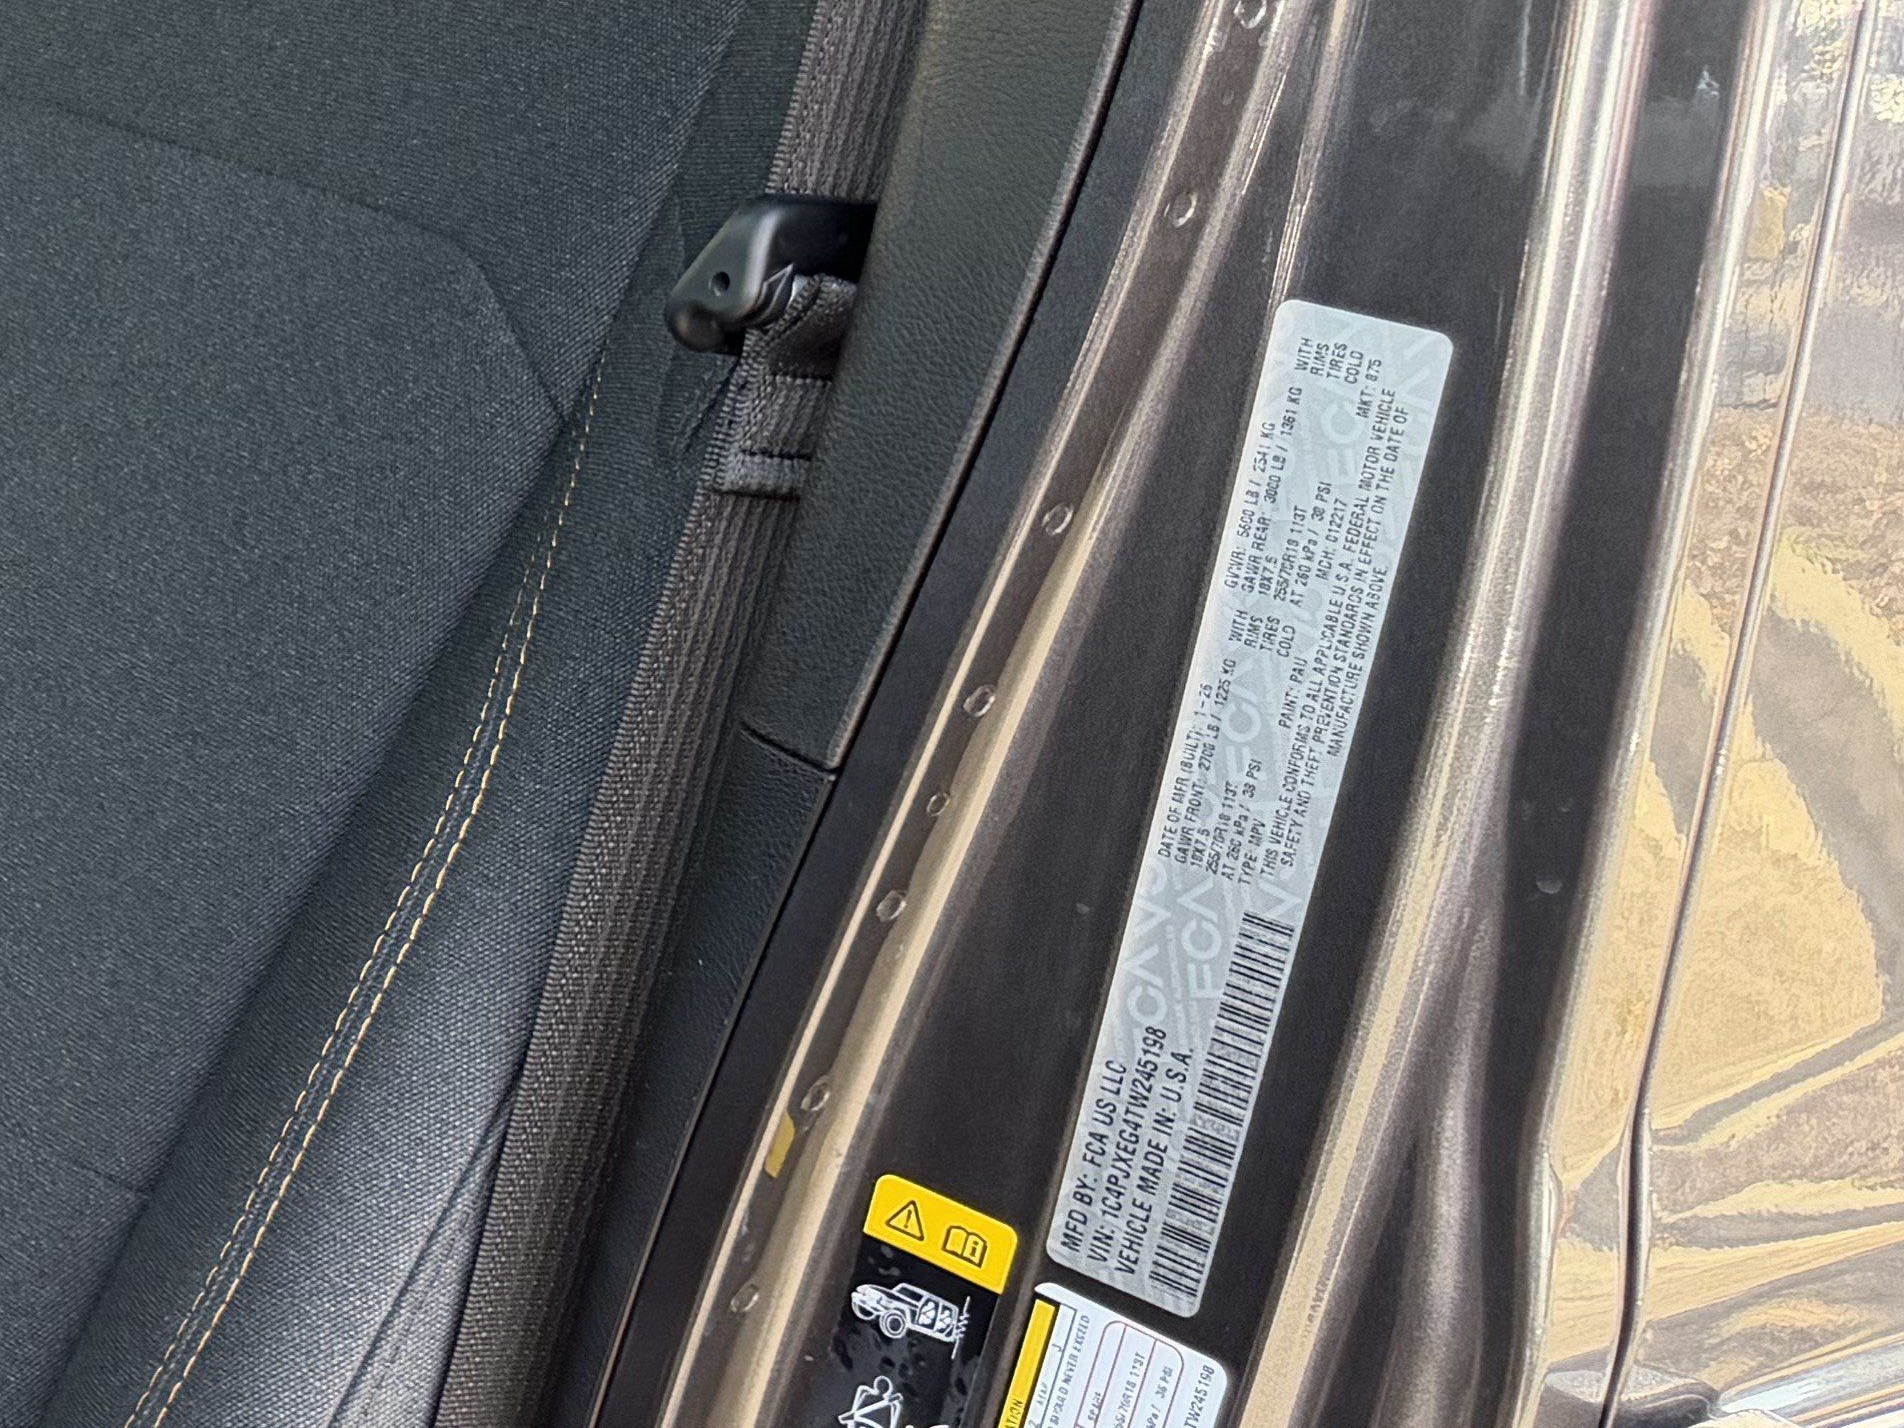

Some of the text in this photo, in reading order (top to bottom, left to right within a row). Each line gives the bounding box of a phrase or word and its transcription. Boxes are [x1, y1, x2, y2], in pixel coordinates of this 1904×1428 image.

[1293, 336, 1315, 372] WITH
[1309, 341, 1330, 376] RIMS
[1325, 340, 1348, 381] TIRES
[1342, 349, 1364, 385] COLD
[1369, 387, 1396, 441] VEHICLE
[1392, 404, 1410, 424] OF
[1243, 488, 1260, 505] LB
[1259, 420, 1276, 440] KG
[1382, 426, 1405, 462] DATE
[1357, 444, 1382, 491] MOTOR
[1375, 464, 1395, 492] THE
[1240, 553, 1262, 594] GAWR
[1285, 385, 1303, 405] KG
[1369, 493, 1387, 514] ON
[1341, 493, 1370, 553] FEDERAL
[1356, 516, 1382, 565] EFFECT
[1288, 589, 1305, 608] AT
[1314, 480, 1332, 503] PSI
[1228, 608, 1248, 644] WITH
[1243, 614, 1263, 648] RIMS
[1259, 614, 1281, 653] TIRES
[1275, 623, 1297, 659] COLD
[1311, 597, 1343, 675] APPLICABLE
[1331, 584, 1364, 663] STANDARDS
[1288, 655, 1308, 684] PAU
[1304, 676, 1323, 701] ALL
[1325, 661, 1363, 757] MANUFACTURE
[1350, 611, 1375, 660] SHOWN
[1299, 702, 1316, 722] TO
[1173, 824, 1194, 864] GAWR
[1212, 677, 1231, 708] 1225
[1281, 722, 1311, 793] CONFORMS
[1165, 805, 1182, 824] OF
[1220, 863, 1236, 880] AT
[1244, 757, 1262, 780] PSI
[1267, 793, 1293, 846] VEHICLE
[1292, 788, 1312, 818] AND
[1157, 824, 1177, 859] DATE
[1259, 846, 1279, 877] THIS
[1279, 817, 1305, 867] SAFETY
[1059, 1058, 1126, 1254] MFD BY: FCA US LLC
[1087, 1023, 1167, 1266] VIN: 1C4PJXEG4TW245198
[1114, 1041, 1193, 1278] VEHICLE MADE IN: U.S.A.
